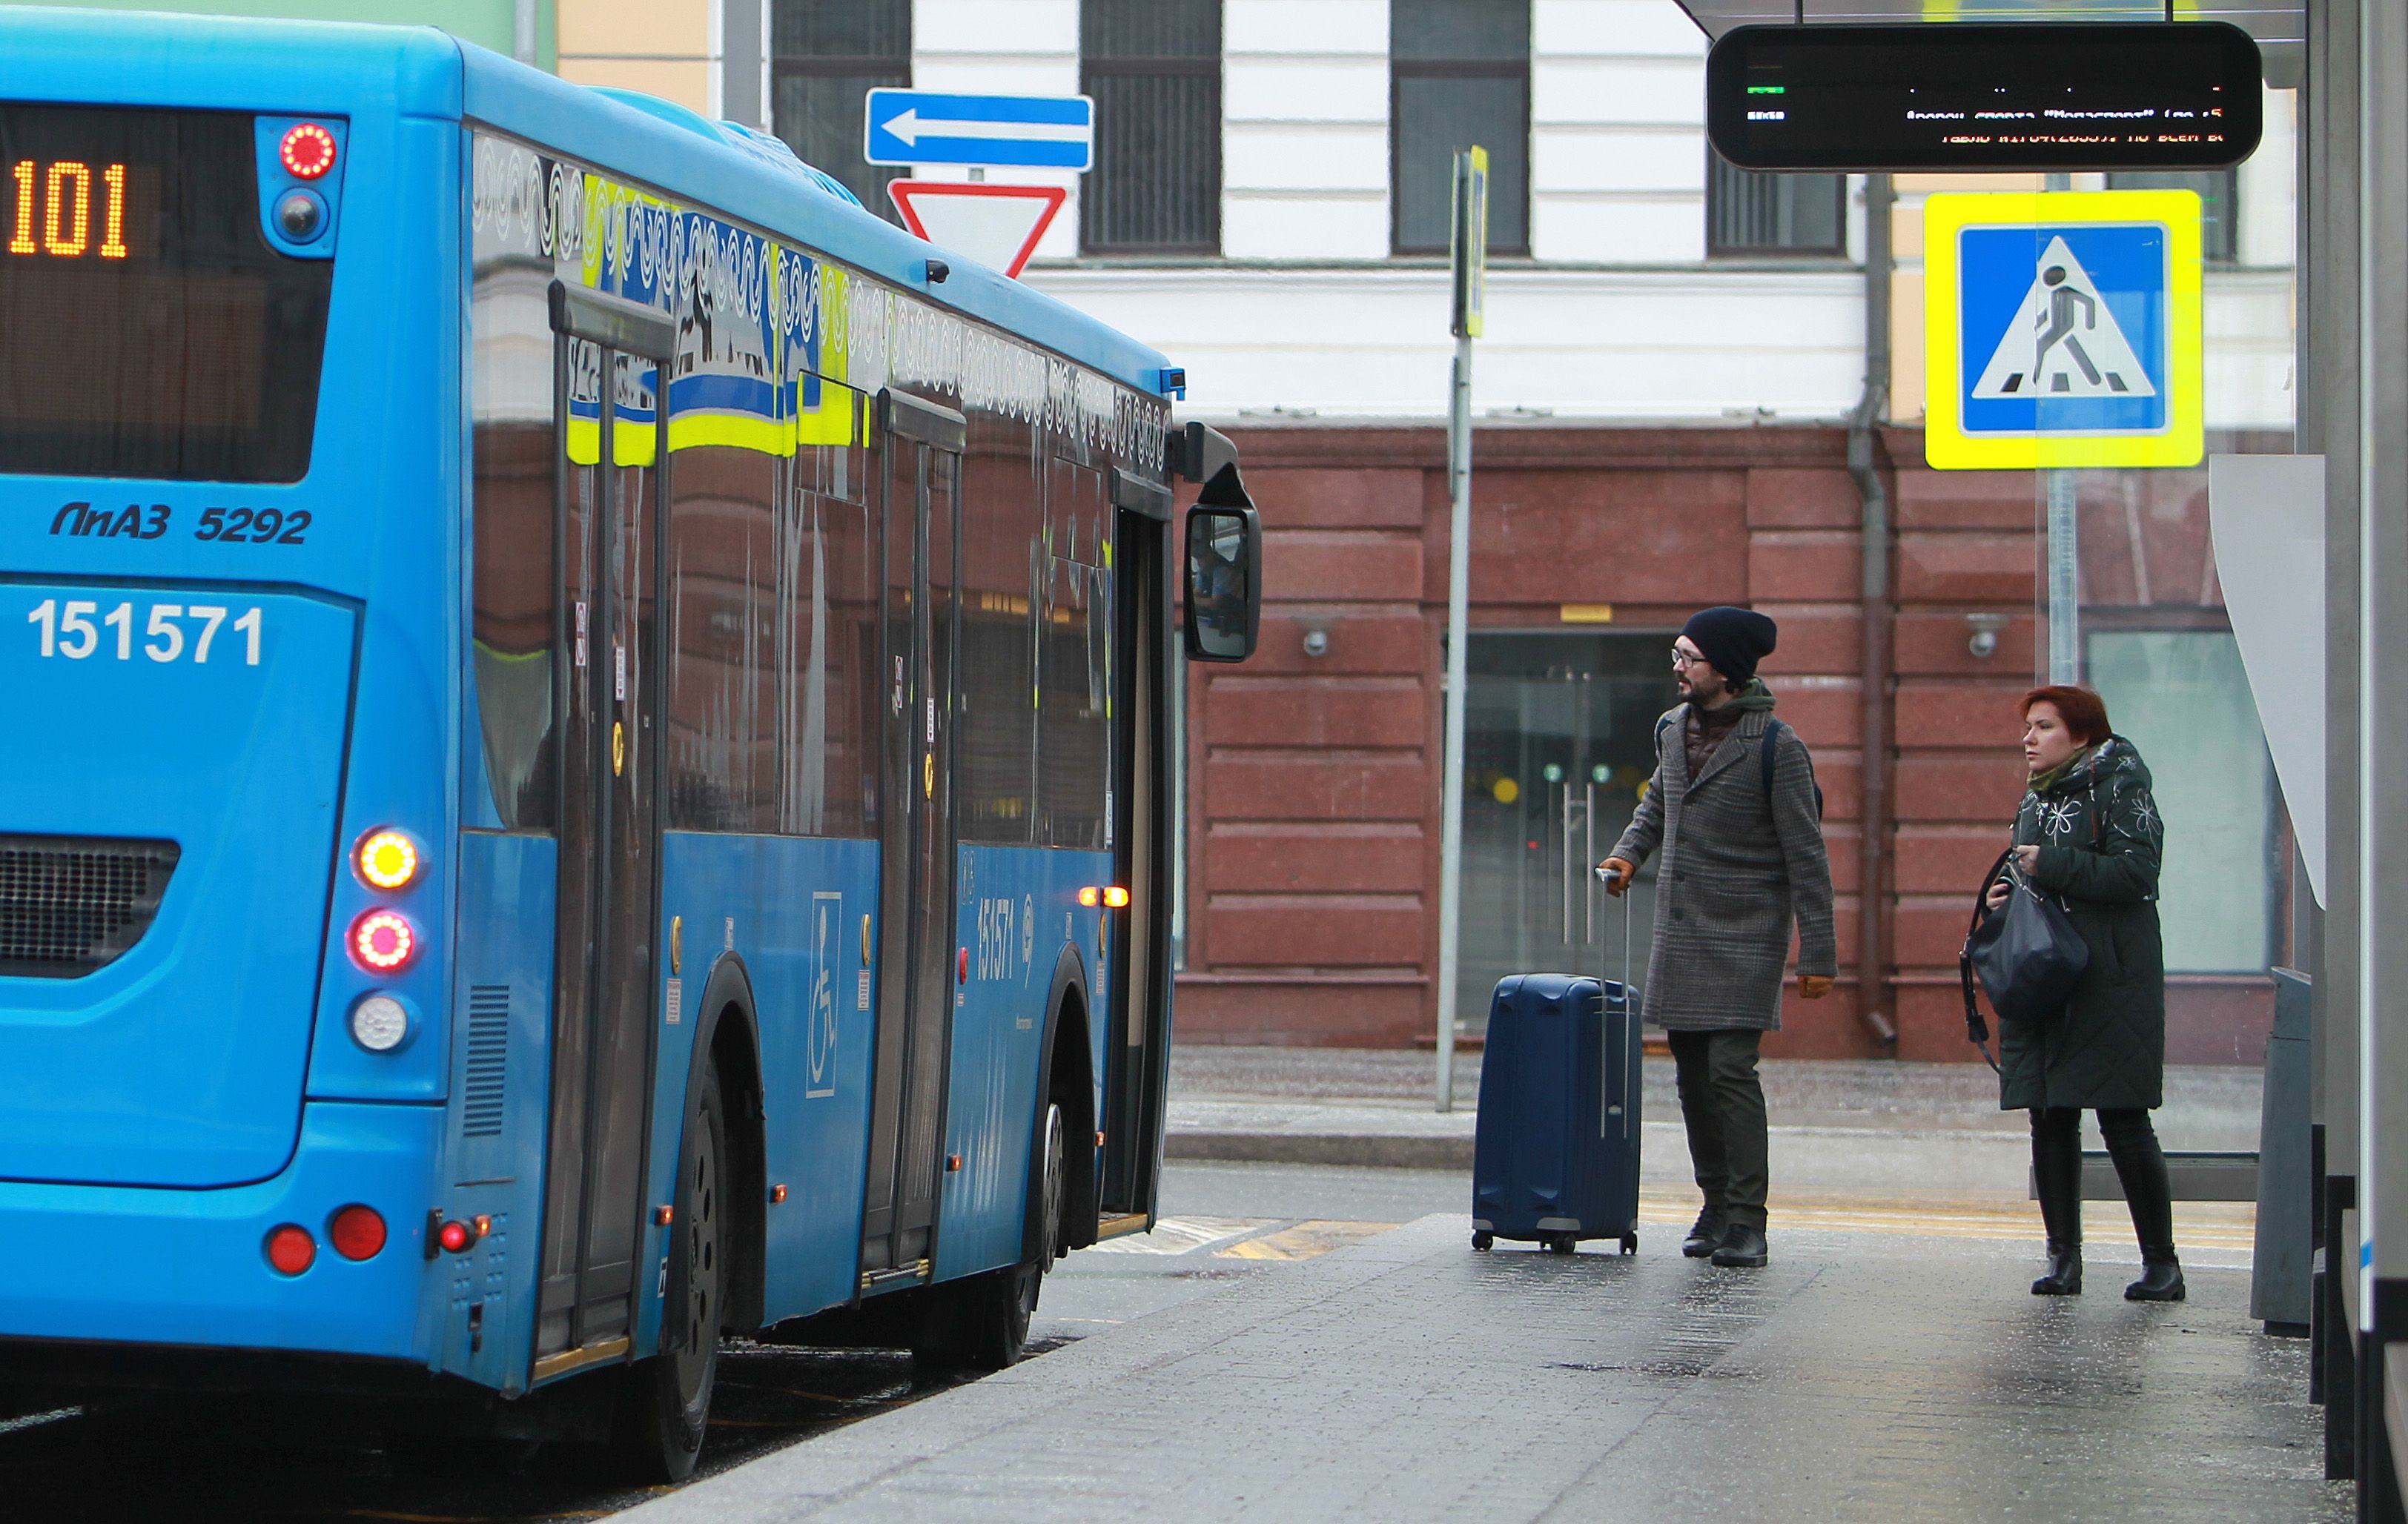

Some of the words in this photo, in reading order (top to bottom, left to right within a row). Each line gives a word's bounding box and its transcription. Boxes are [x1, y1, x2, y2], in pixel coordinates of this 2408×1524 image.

[10, 160, 127, 258] 101
[49, 502, 171, 540] ЛиАЗ
[194, 508, 312, 545] 5292
[27, 598, 262, 666] 151571
[978, 898, 1014, 981] 151571
